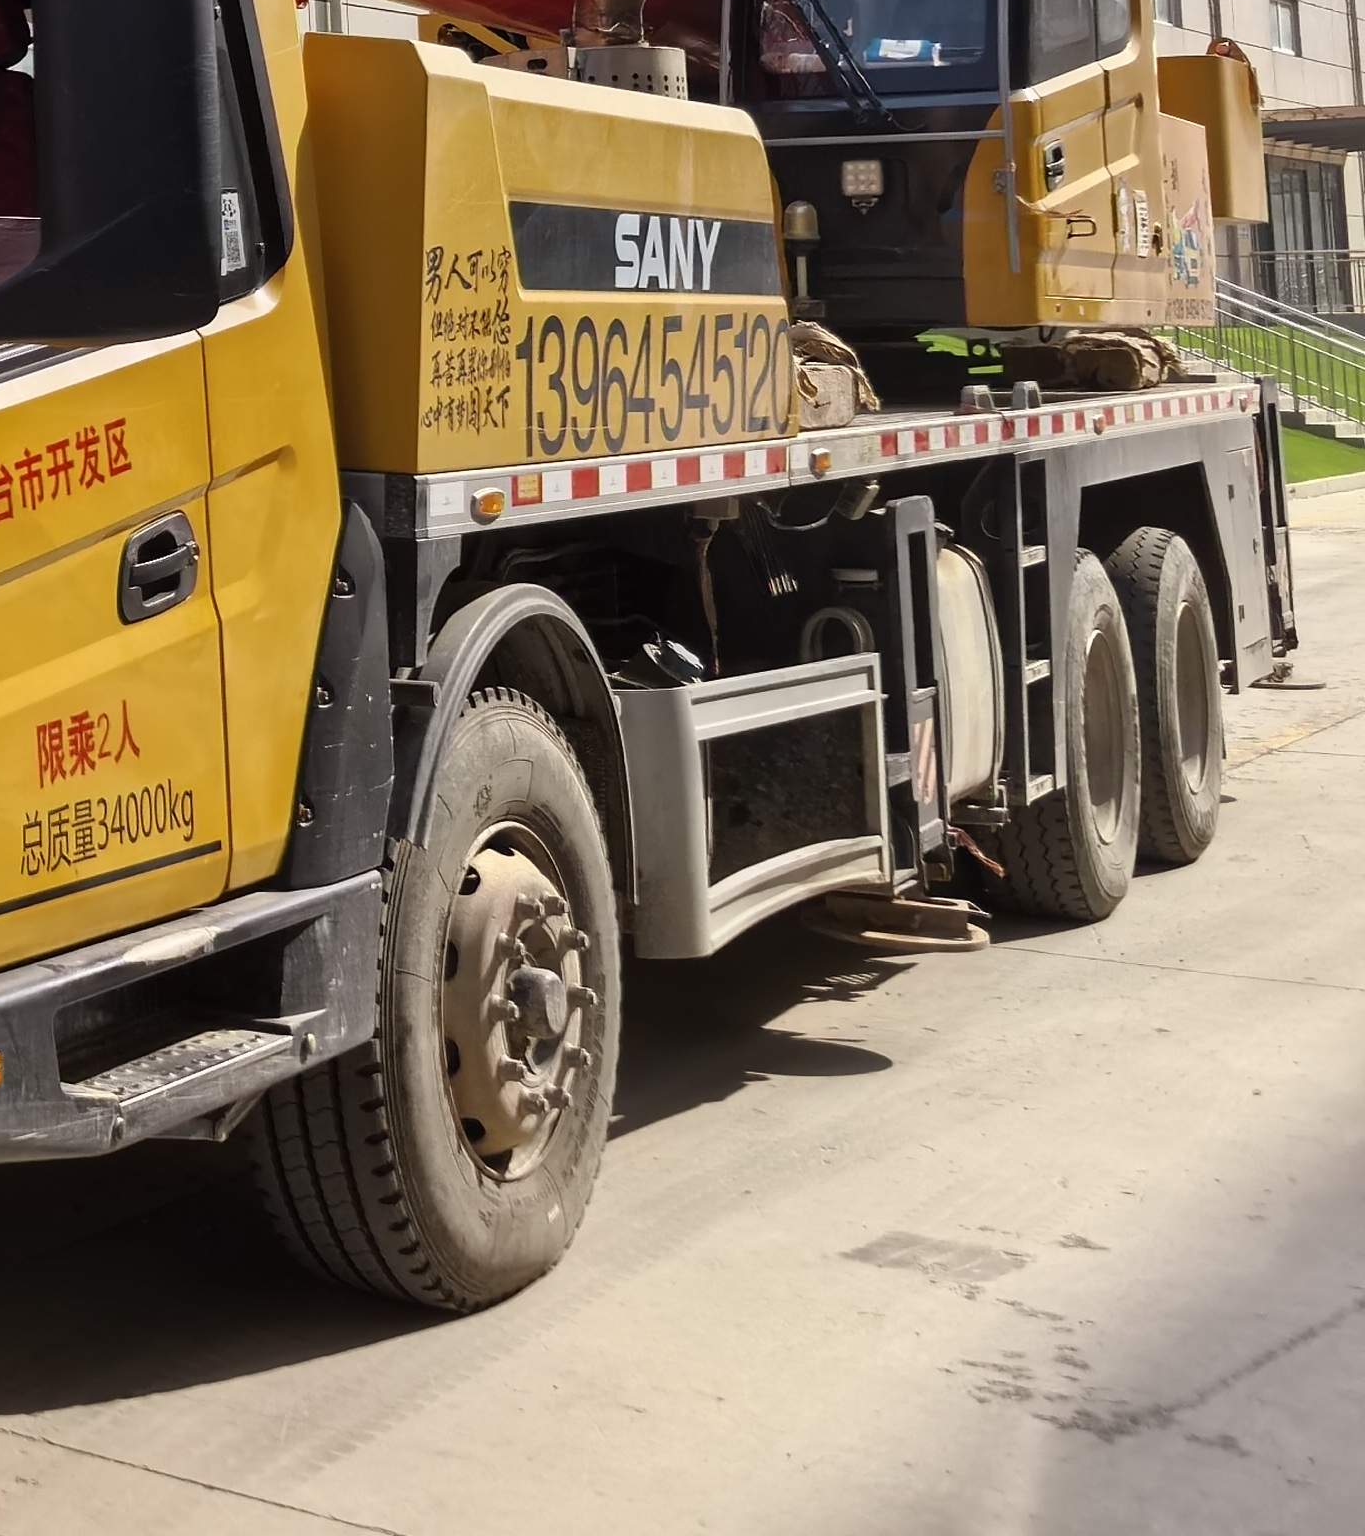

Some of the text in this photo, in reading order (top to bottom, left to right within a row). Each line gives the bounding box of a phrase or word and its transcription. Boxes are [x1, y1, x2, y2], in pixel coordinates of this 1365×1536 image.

[614, 213, 722, 291] SANY
[515, 312, 793, 458] 13964545120
[36, 699, 141, 789] 限乘2人
[20, 778, 195, 877] 总质量34000kg
